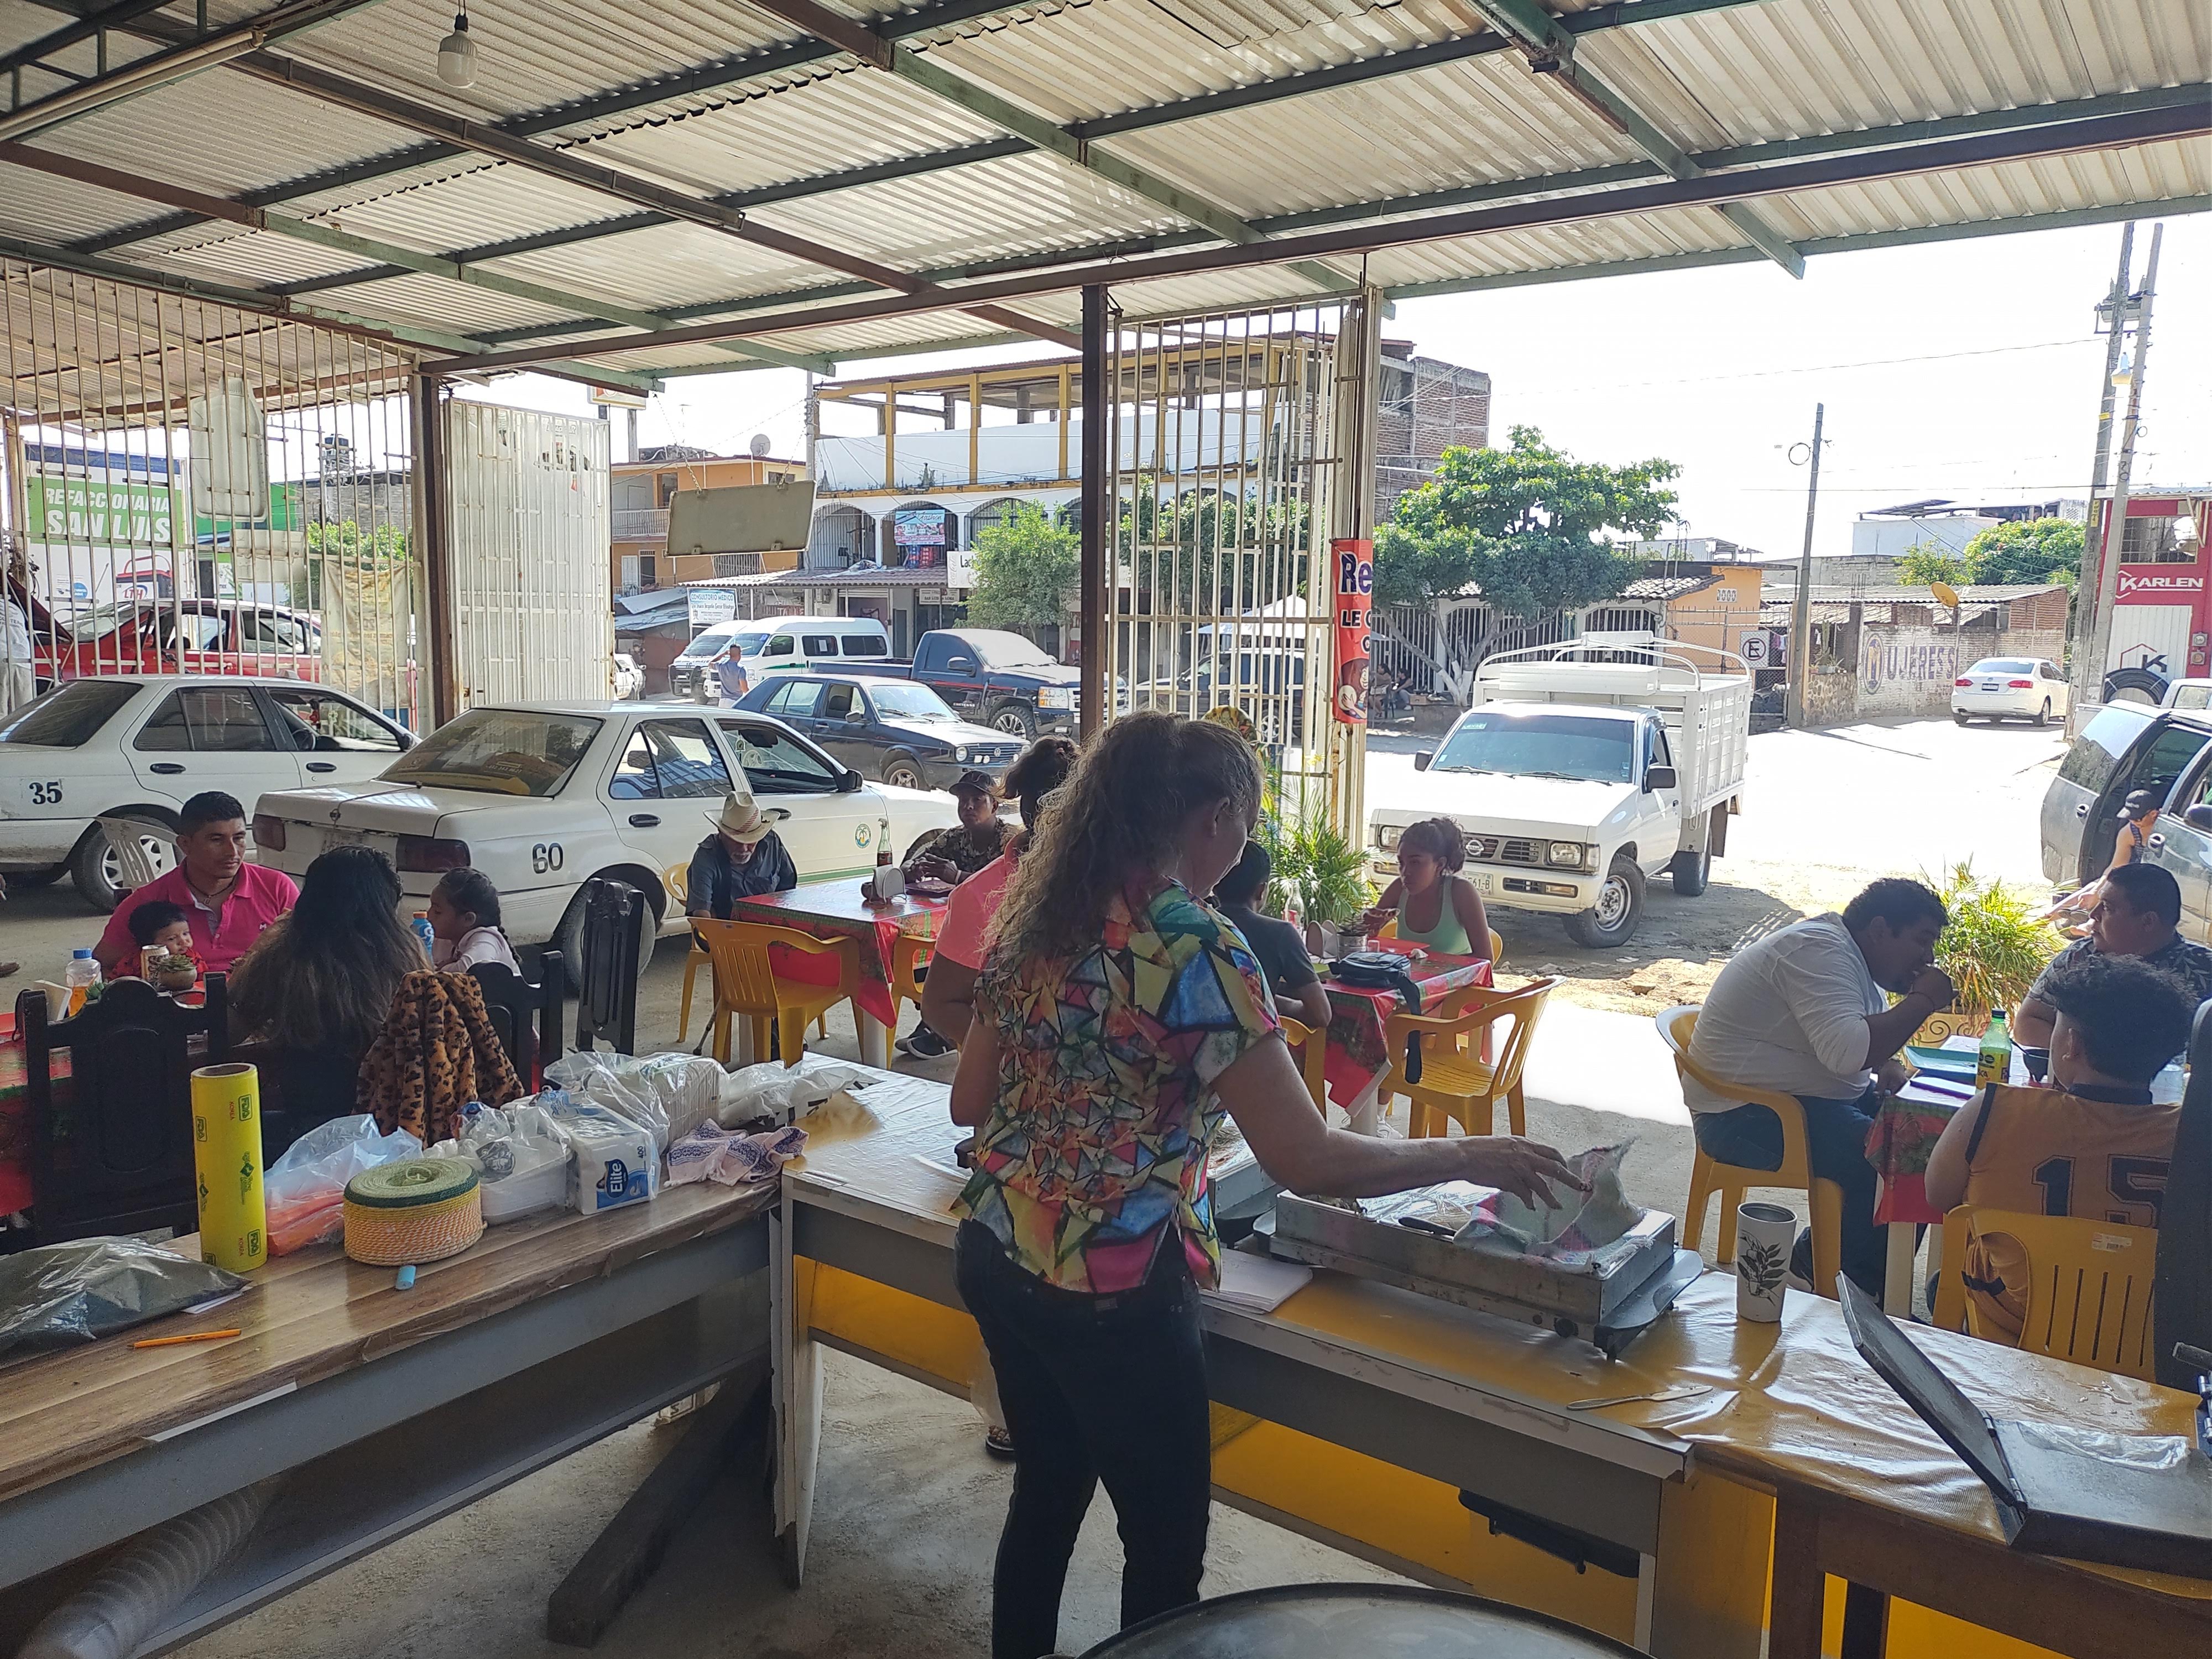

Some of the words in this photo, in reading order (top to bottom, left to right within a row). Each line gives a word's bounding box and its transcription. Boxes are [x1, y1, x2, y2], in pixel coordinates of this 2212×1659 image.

[46, 488, 169, 513] REFACCONARIA
[48, 509, 105, 538] SAN
[113, 514, 171, 542] LUIS
[2120, 577, 2204, 592] KARLEN
[1341, 609, 1362, 628] LE
[2141, 655, 2168, 673] K
[29, 782, 62, 805] 35
[532, 842, 564, 874] 60
[610, 1163, 623, 1193] Elite
[2031, 1154, 2171, 1228] 15
